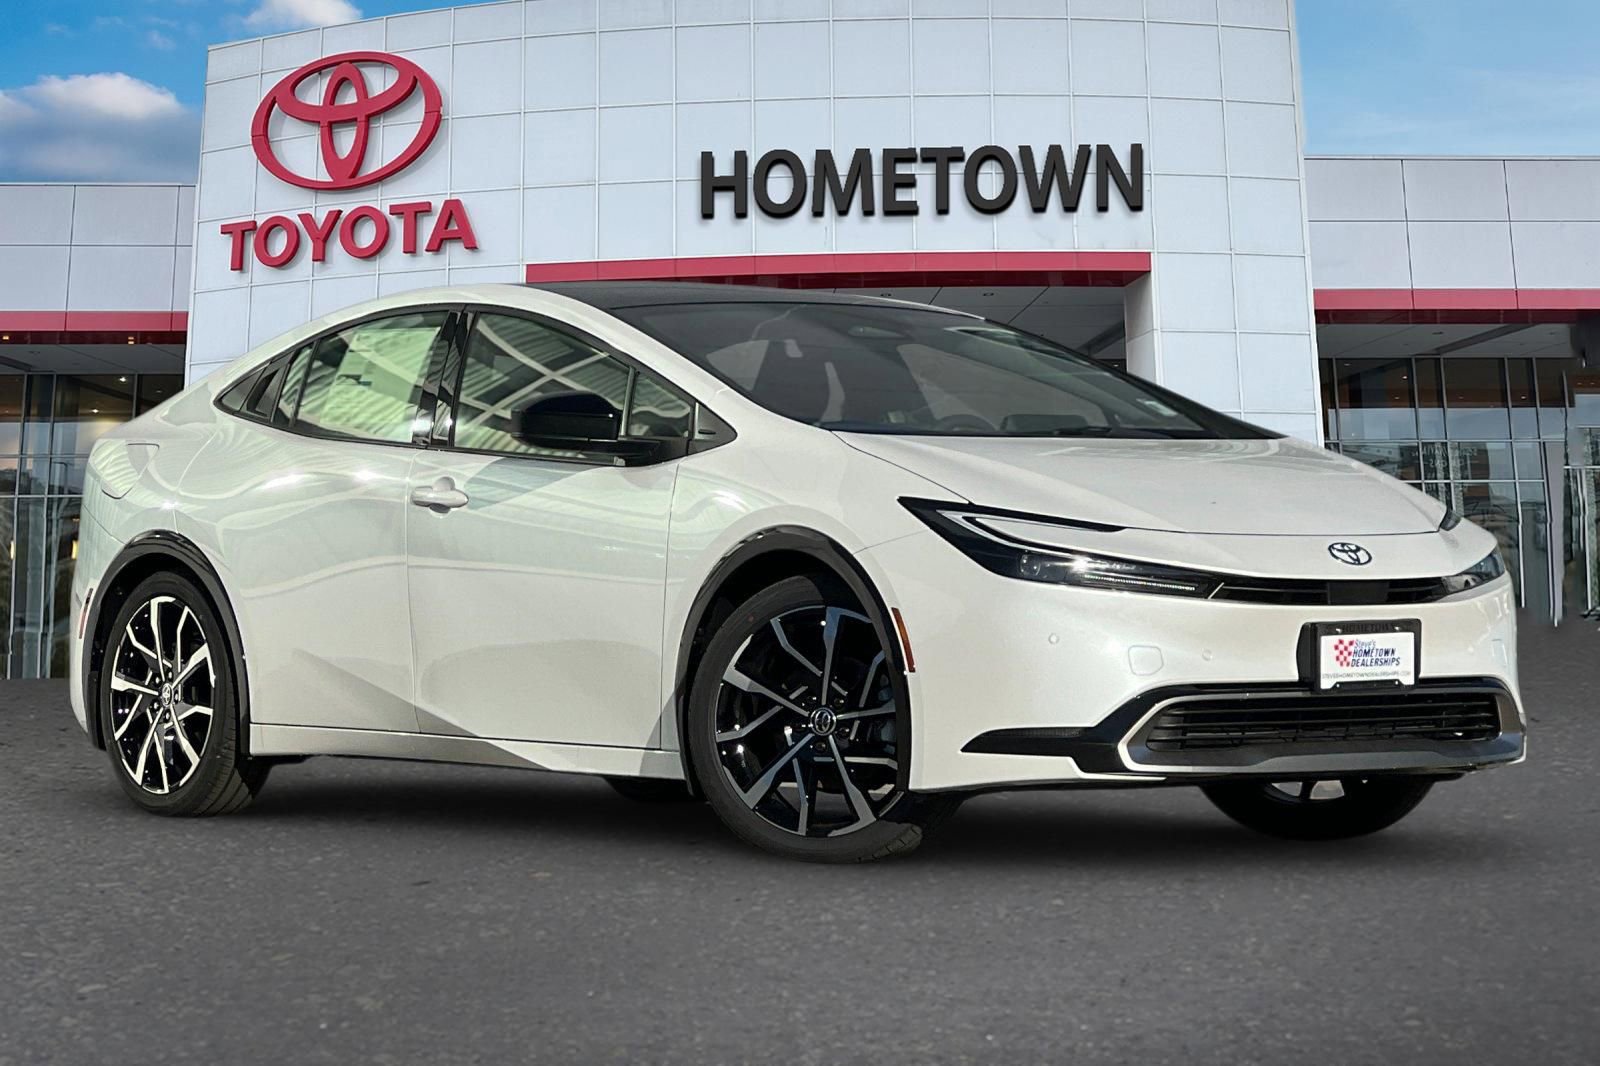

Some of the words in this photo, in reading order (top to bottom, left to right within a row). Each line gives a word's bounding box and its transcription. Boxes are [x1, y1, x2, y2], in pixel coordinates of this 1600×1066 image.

[700, 143, 1144, 219] HOMETOWN
[220, 198, 479, 271] TOYOTA
[1354, 639, 1376, 648] Steve's
[1352, 647, 1396, 657] HOMETOWN
[1350, 657, 1401, 667] DEALERSHIPS
